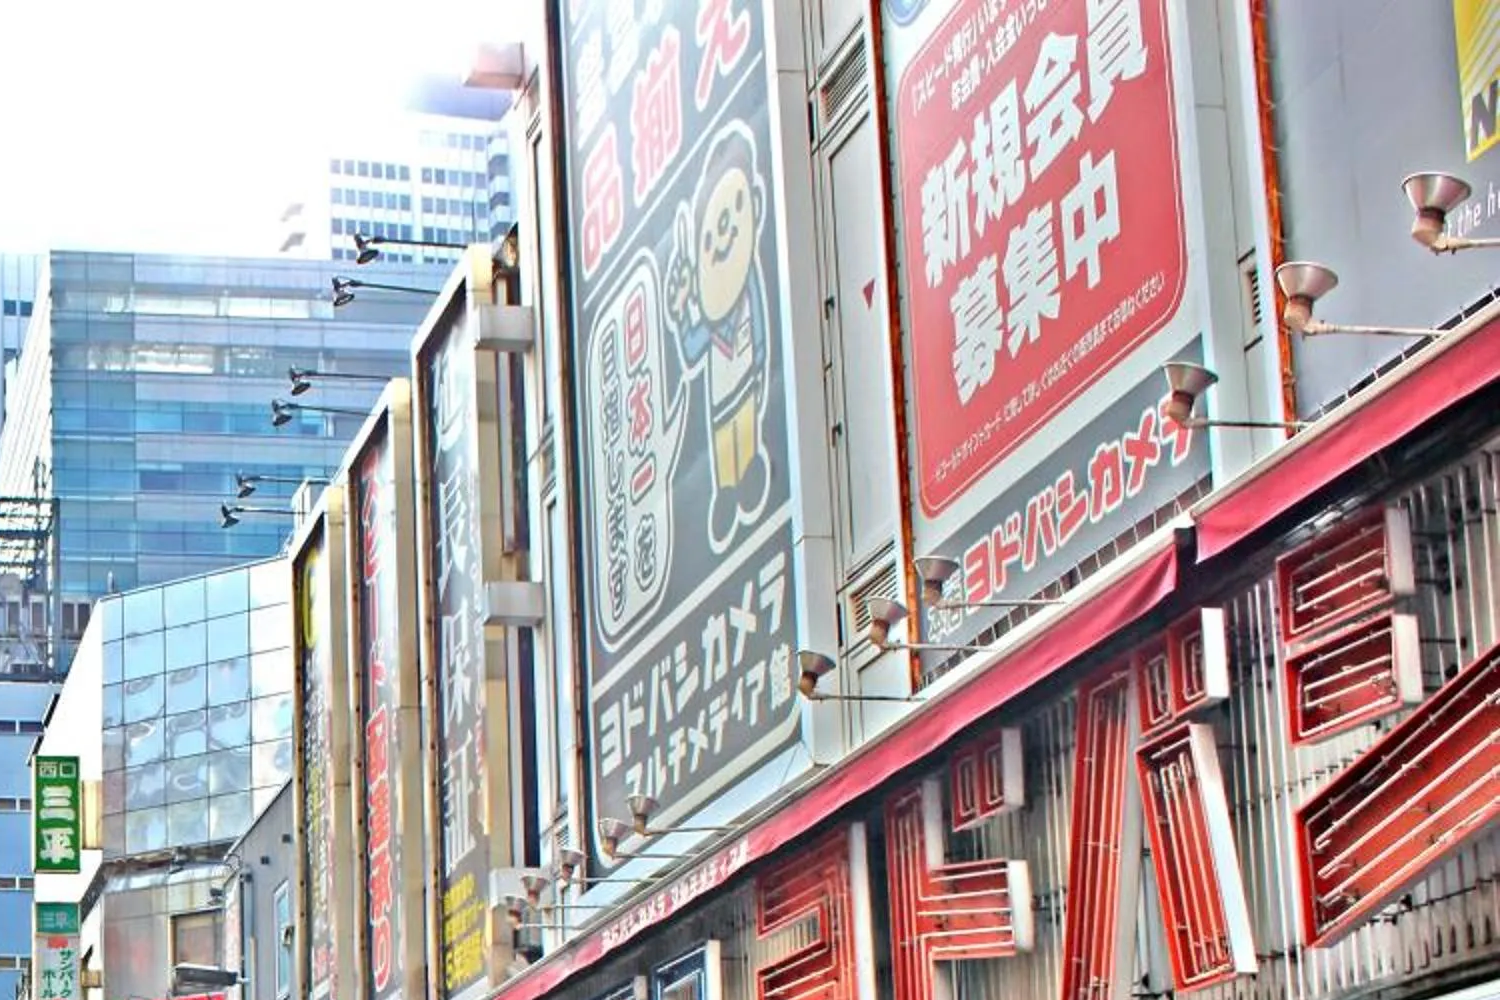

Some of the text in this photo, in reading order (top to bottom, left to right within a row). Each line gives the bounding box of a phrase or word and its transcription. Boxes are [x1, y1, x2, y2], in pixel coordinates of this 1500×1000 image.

[920, 0, 1150, 290] 新規会員
[950, 151, 1121, 406] 募集中
[39, 762, 76, 778] 西口
[600, 551, 786, 778] ヨドバシカメラ
[625, 642, 794, 801] マルチメディア館
